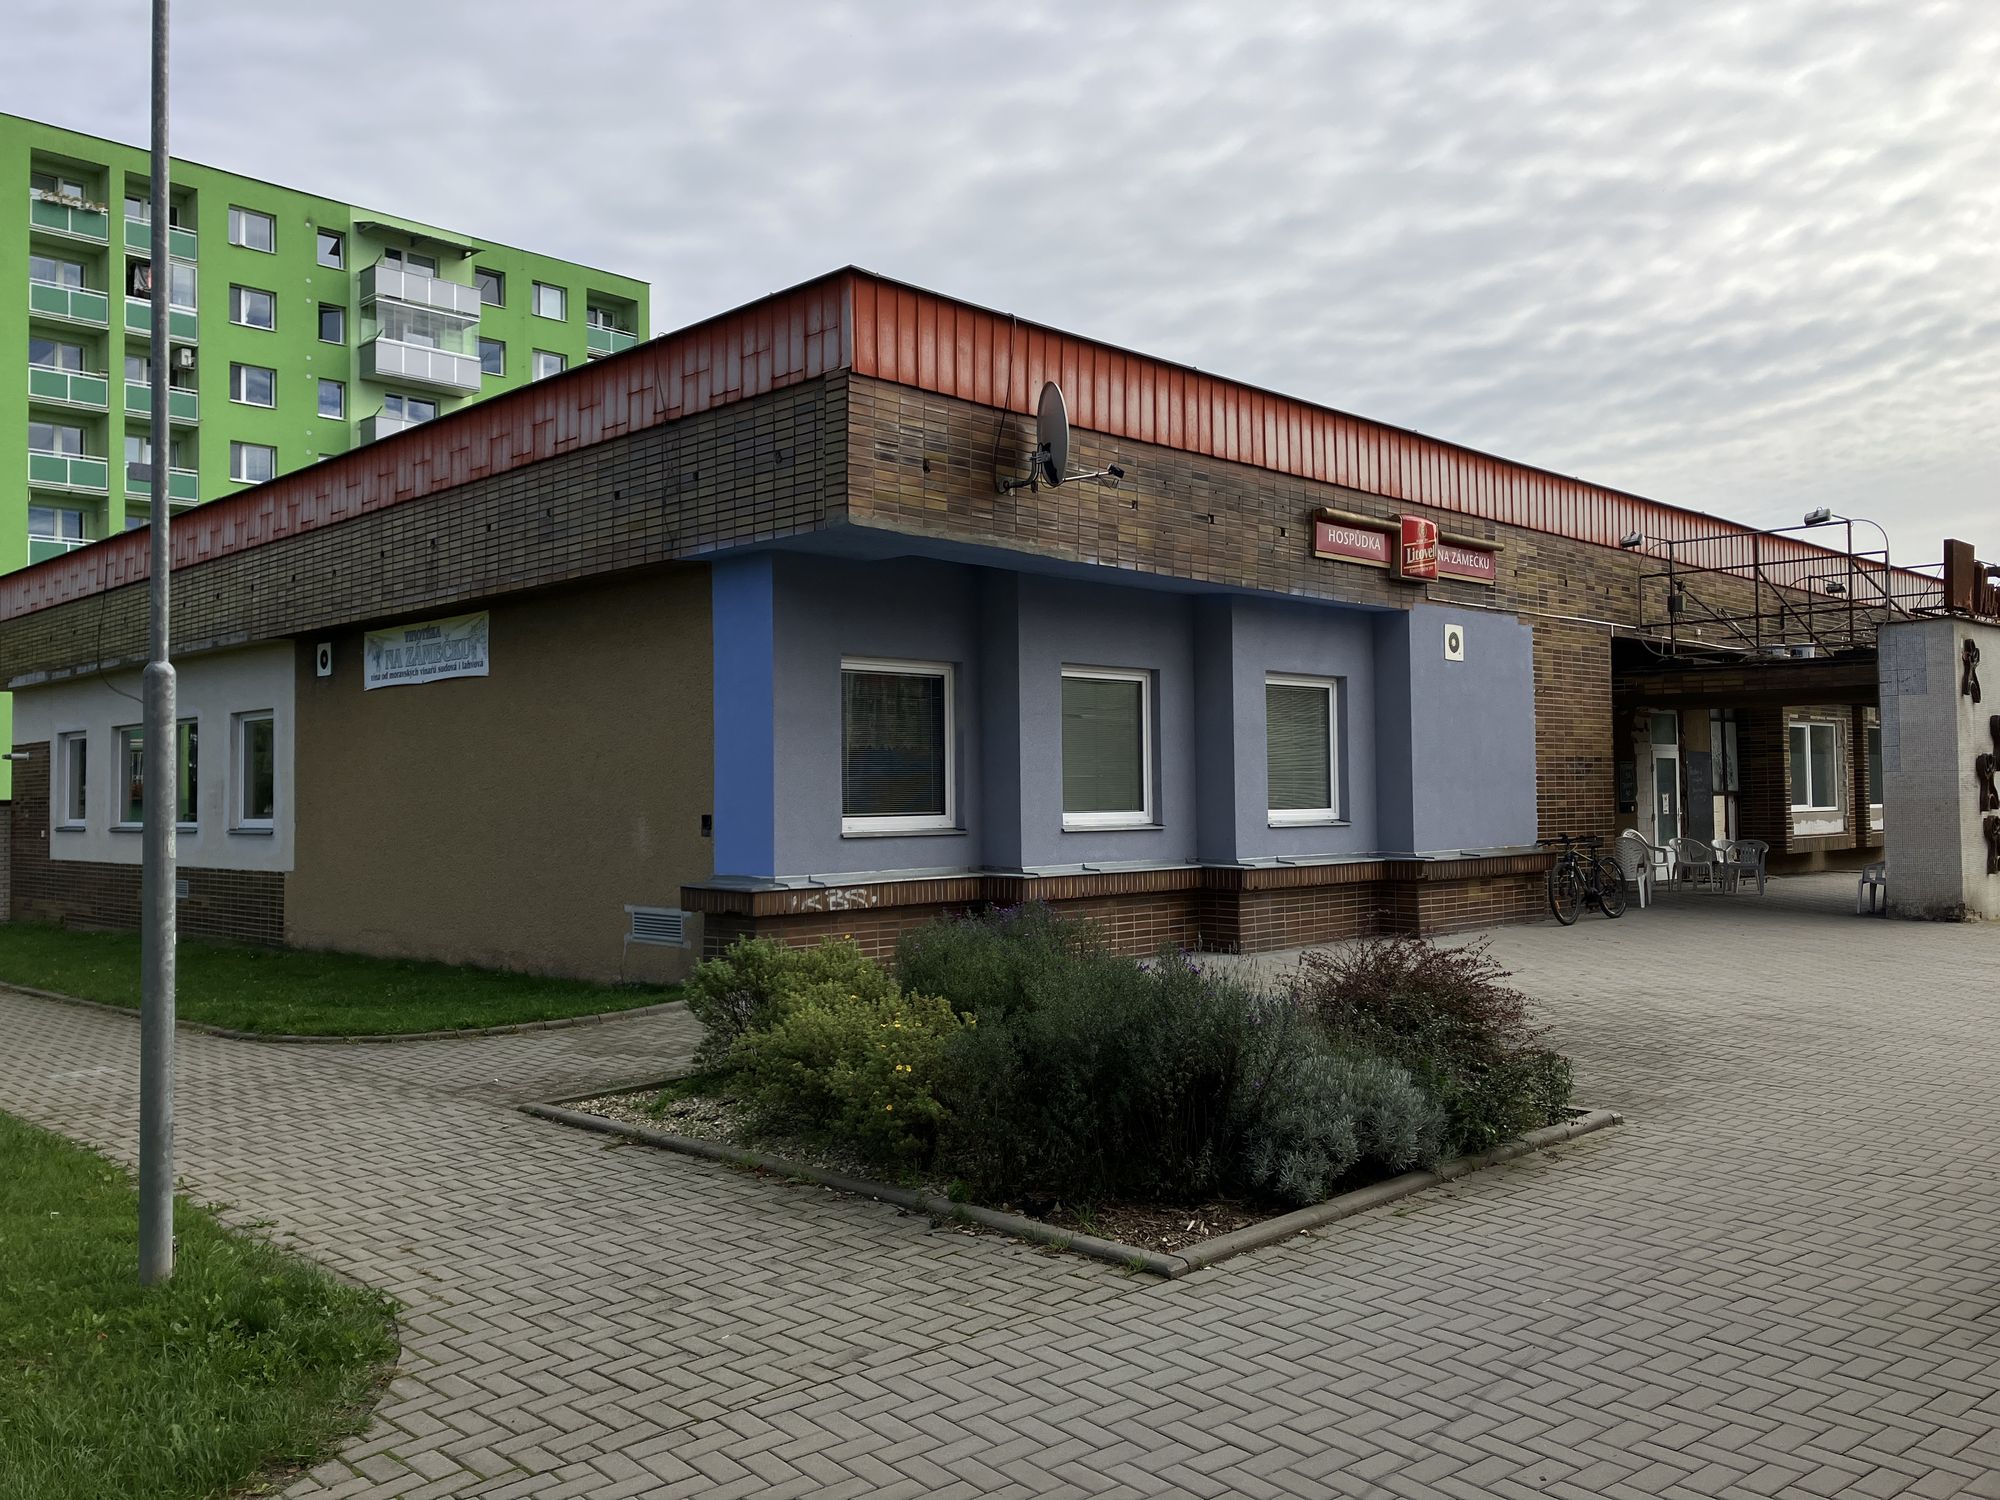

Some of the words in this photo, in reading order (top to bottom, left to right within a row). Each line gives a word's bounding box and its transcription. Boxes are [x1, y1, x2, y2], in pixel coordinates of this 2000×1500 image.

[1328, 529, 1381, 551] HOSPŮDKA
[1406, 544, 1435, 564] Litovel
[1438, 549, 1450, 563] NA
[1451, 549, 1490, 570] ZÁMEČKU
[385, 648, 403, 670] NA
[405, 633, 471, 668] ZÁMEČKU
